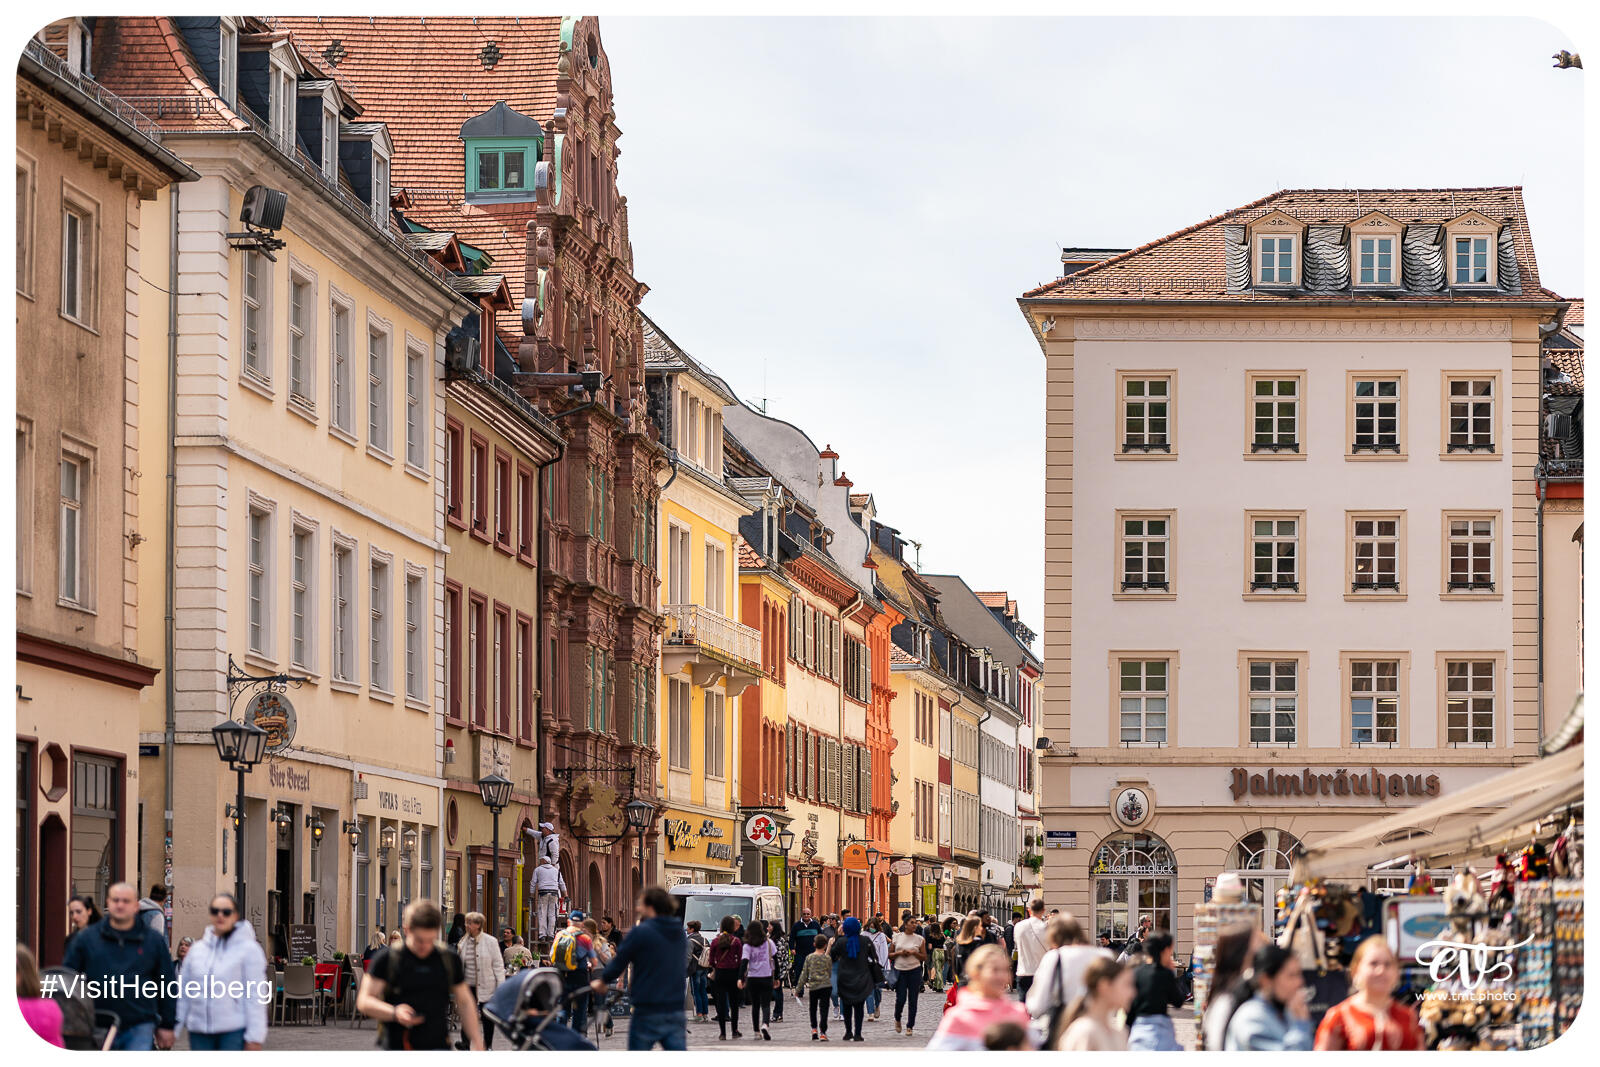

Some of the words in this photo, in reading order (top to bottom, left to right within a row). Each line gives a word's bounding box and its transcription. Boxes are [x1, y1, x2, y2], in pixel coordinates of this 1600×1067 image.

[269, 763, 285, 788] Bier
[287, 766, 311, 792] Brezel
[1229, 767, 1441, 801] Palmbräuhaus
[1148, 858, 1174, 877] glück
